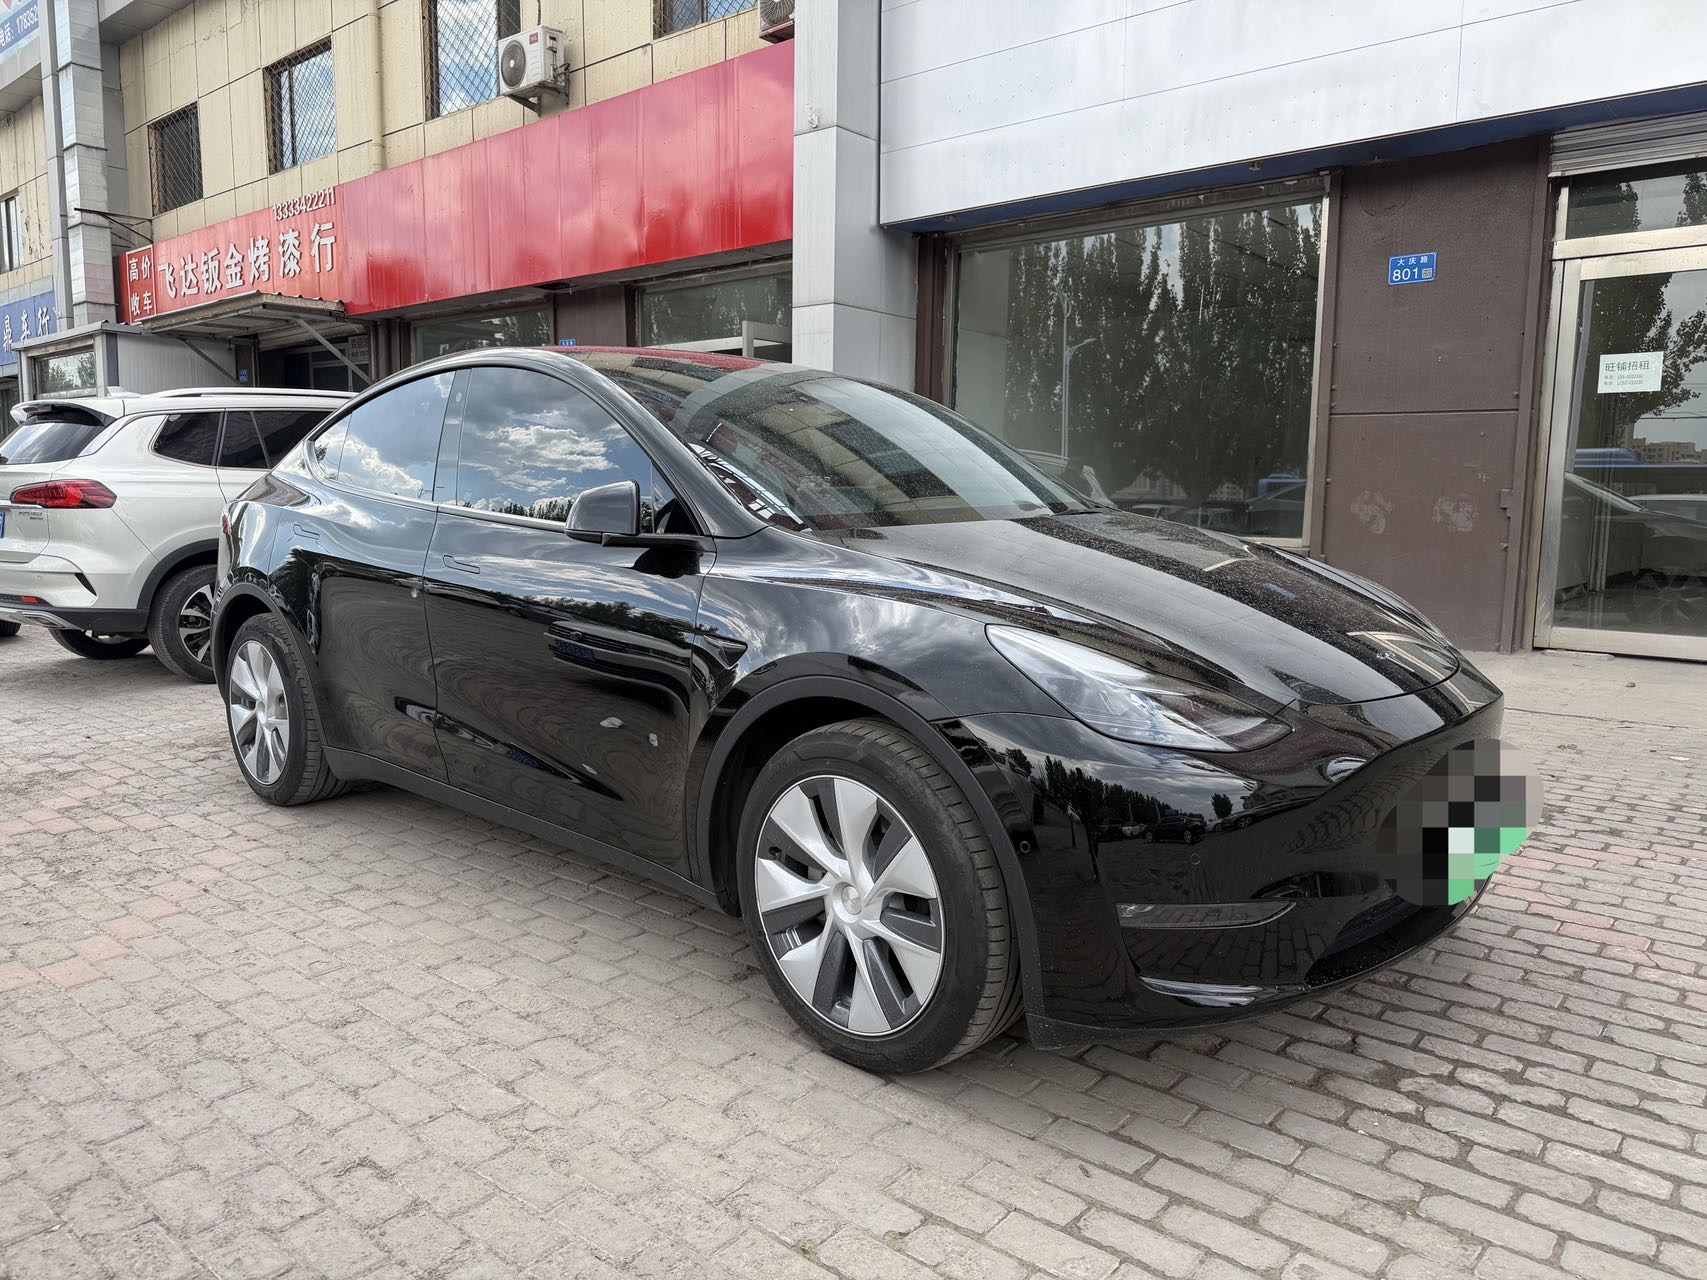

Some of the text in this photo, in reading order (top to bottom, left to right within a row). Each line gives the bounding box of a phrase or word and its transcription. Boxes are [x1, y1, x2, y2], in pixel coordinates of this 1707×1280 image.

[273, 186, 335, 221] 13333422211
[129, 255, 151, 281] 高价
[158, 221, 336, 299] 飞达钣金烤漆行
[1397, 256, 1428, 266] 大庆路
[1392, 267, 1418, 281] 801
[131, 290, 153, 316] 收车
[1605, 361, 1650, 371] 旺铺招租
